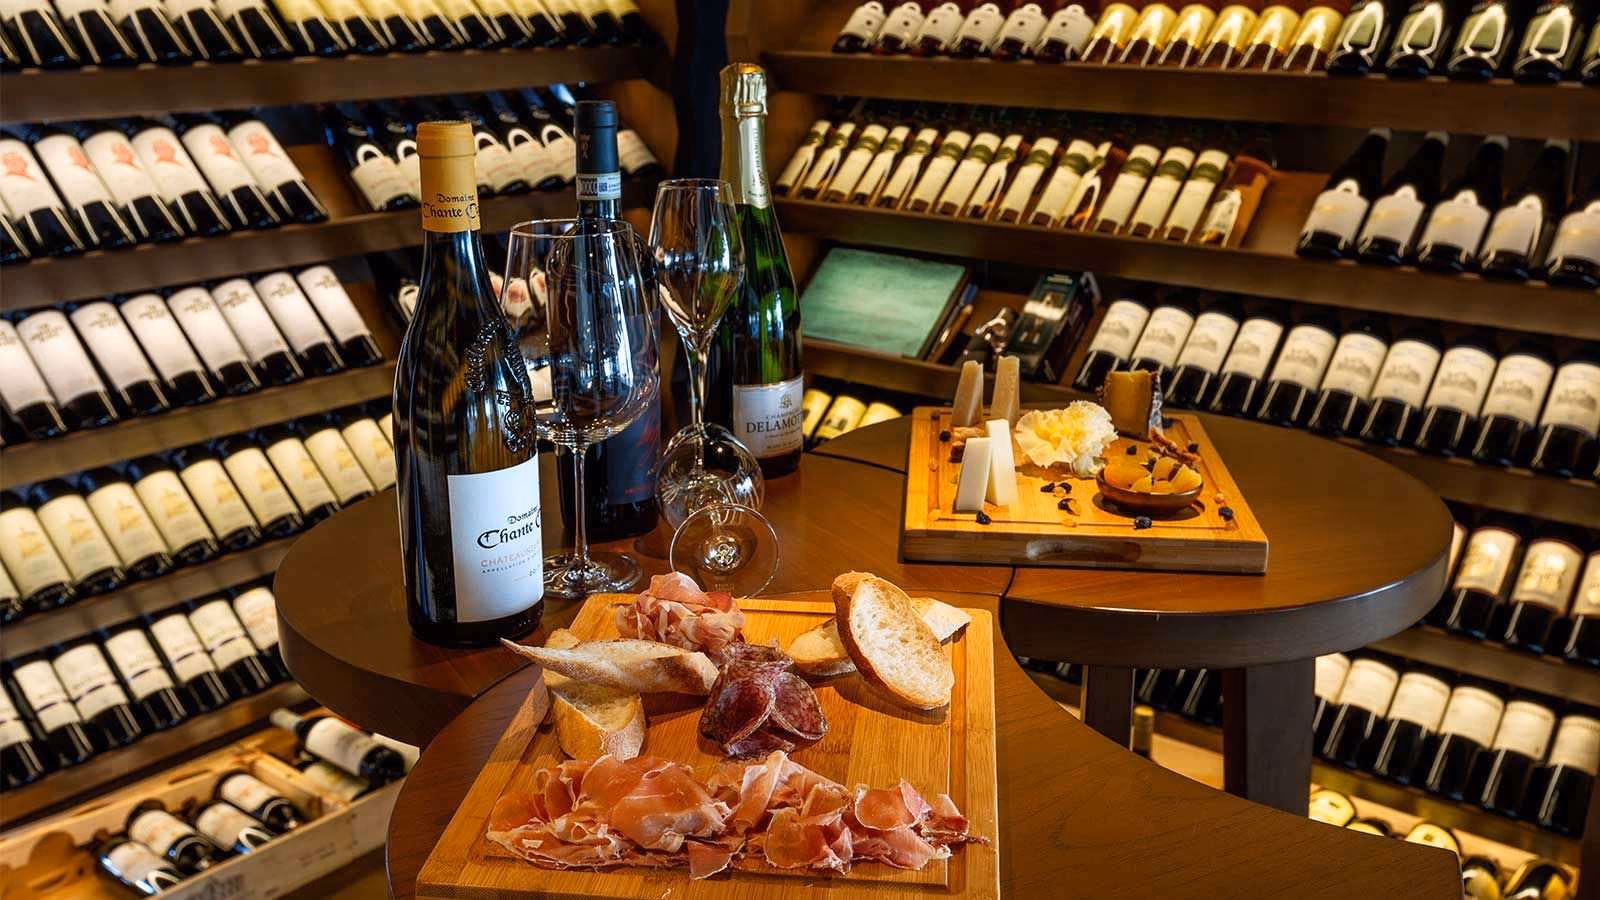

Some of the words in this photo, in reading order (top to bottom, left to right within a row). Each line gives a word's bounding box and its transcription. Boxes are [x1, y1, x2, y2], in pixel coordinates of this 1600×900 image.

[423, 203, 463, 218] Chante
[746, 414, 801, 433] DELAMOT
[476, 521, 534, 549] Chante
